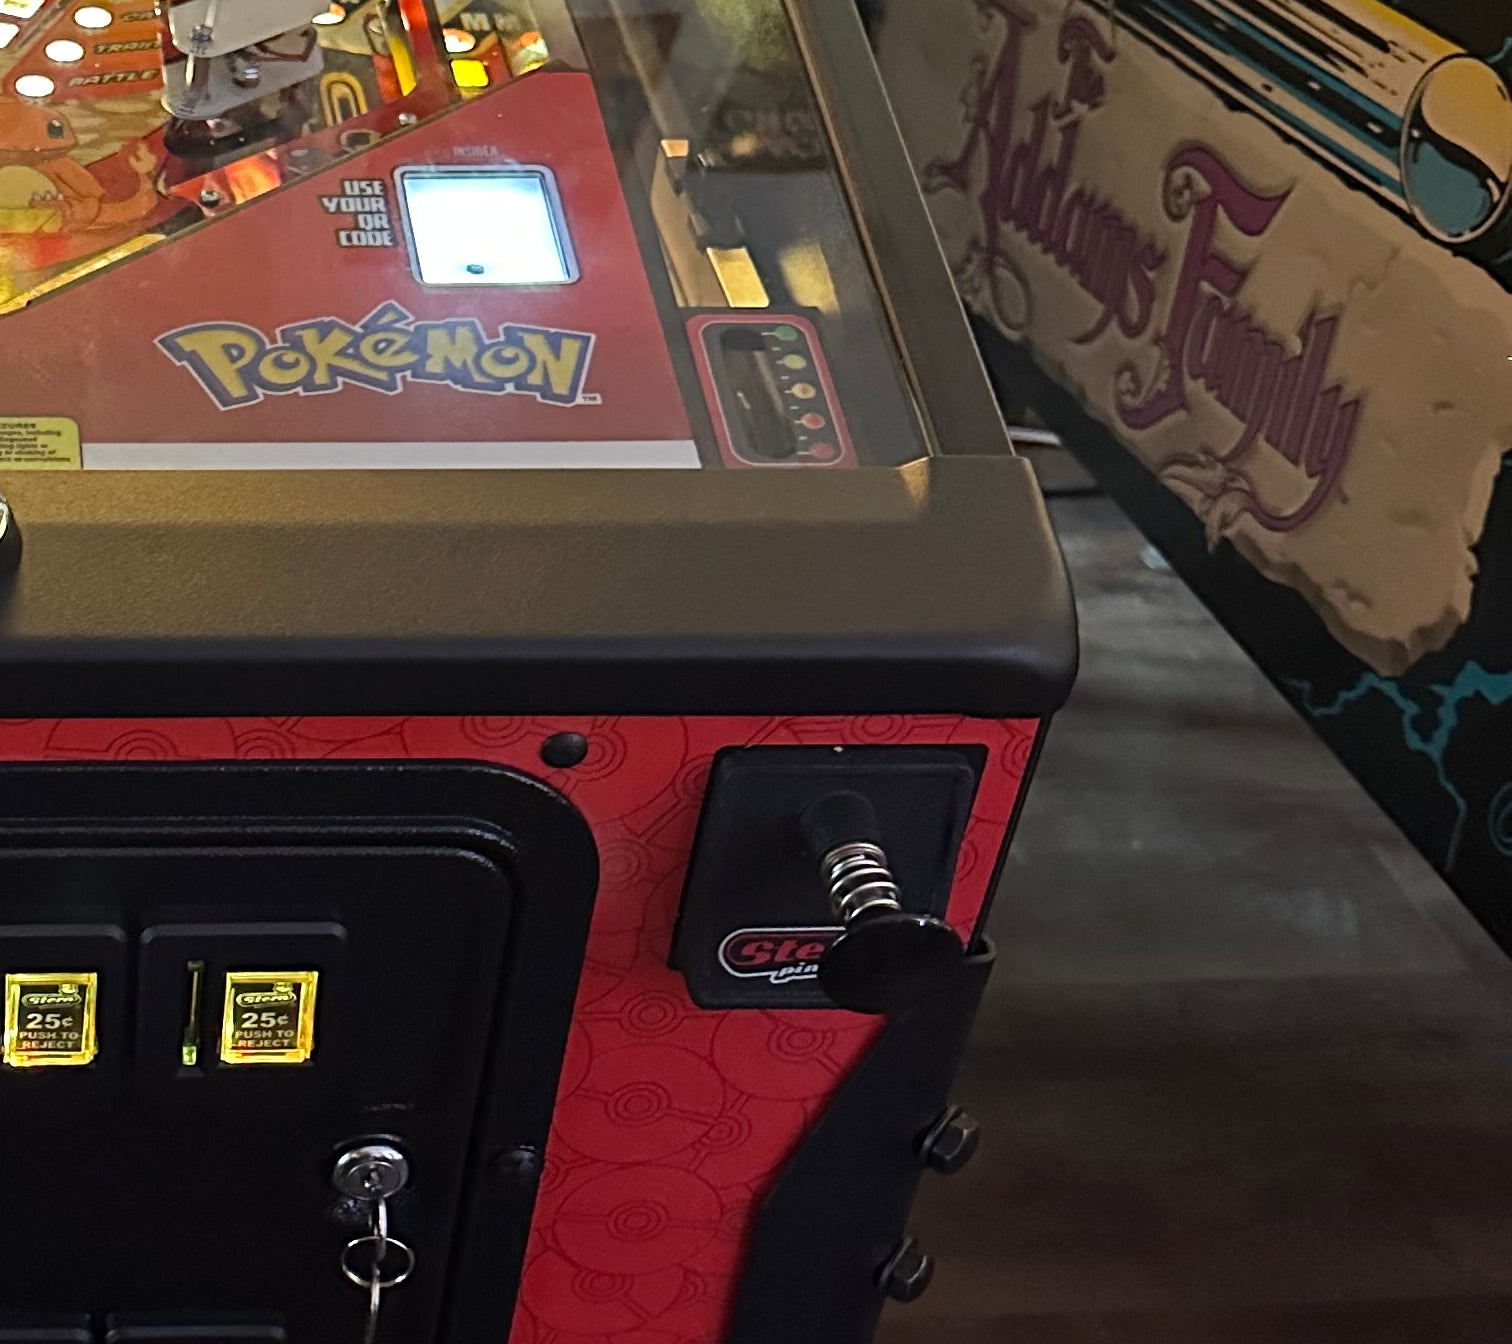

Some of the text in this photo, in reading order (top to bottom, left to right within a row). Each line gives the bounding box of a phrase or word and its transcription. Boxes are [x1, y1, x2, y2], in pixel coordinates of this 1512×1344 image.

[344, 180, 384, 196] USE
[322, 197, 386, 213] YOUR
[358, 213, 390, 231] QR
[339, 230, 394, 247] CODE
[1116, 141, 1362, 534] Family
[739, 938, 825, 964] Ste
[26, 1013, 74, 1030] 25¢
[241, 1012, 289, 1028] 25¢
[19, 1031, 80, 1040] PUSH TO
[235, 1029, 295, 1039] PUSH TO
[22, 1040, 75, 1049] REJECT
[238, 1039, 290, 1048] REJECT
